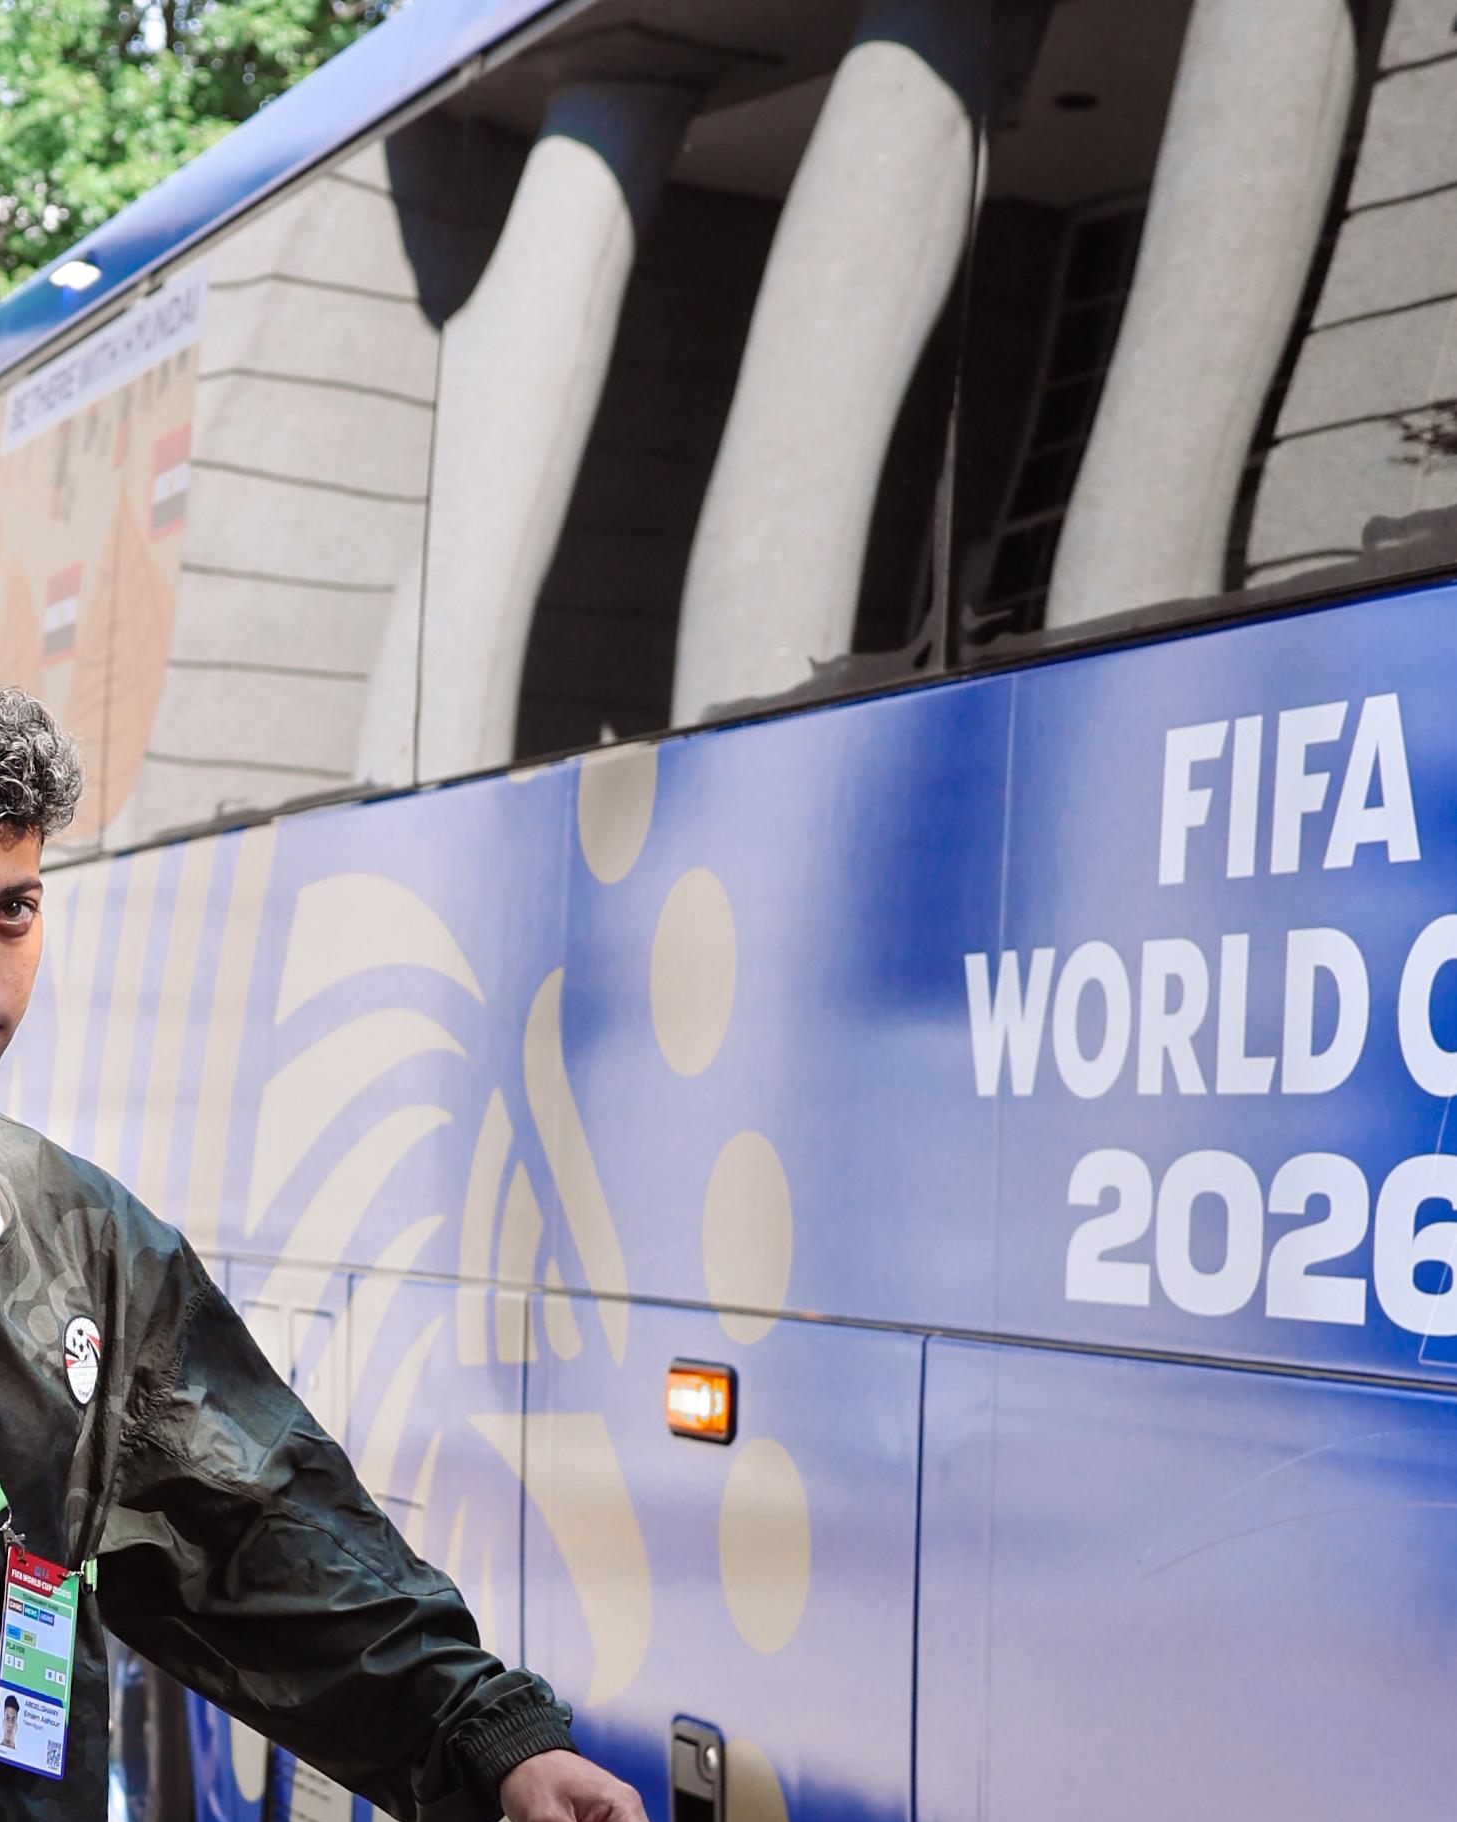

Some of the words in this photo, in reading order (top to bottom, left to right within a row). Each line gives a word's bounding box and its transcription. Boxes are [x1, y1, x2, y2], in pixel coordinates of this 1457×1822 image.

[1158, 692, 1421, 886] FIFA
[964, 927, 1370, 1099] WORLD
[1065, 1148, 1457, 1336] 2026
[6, 1642, 25, 1654] PLAYER
